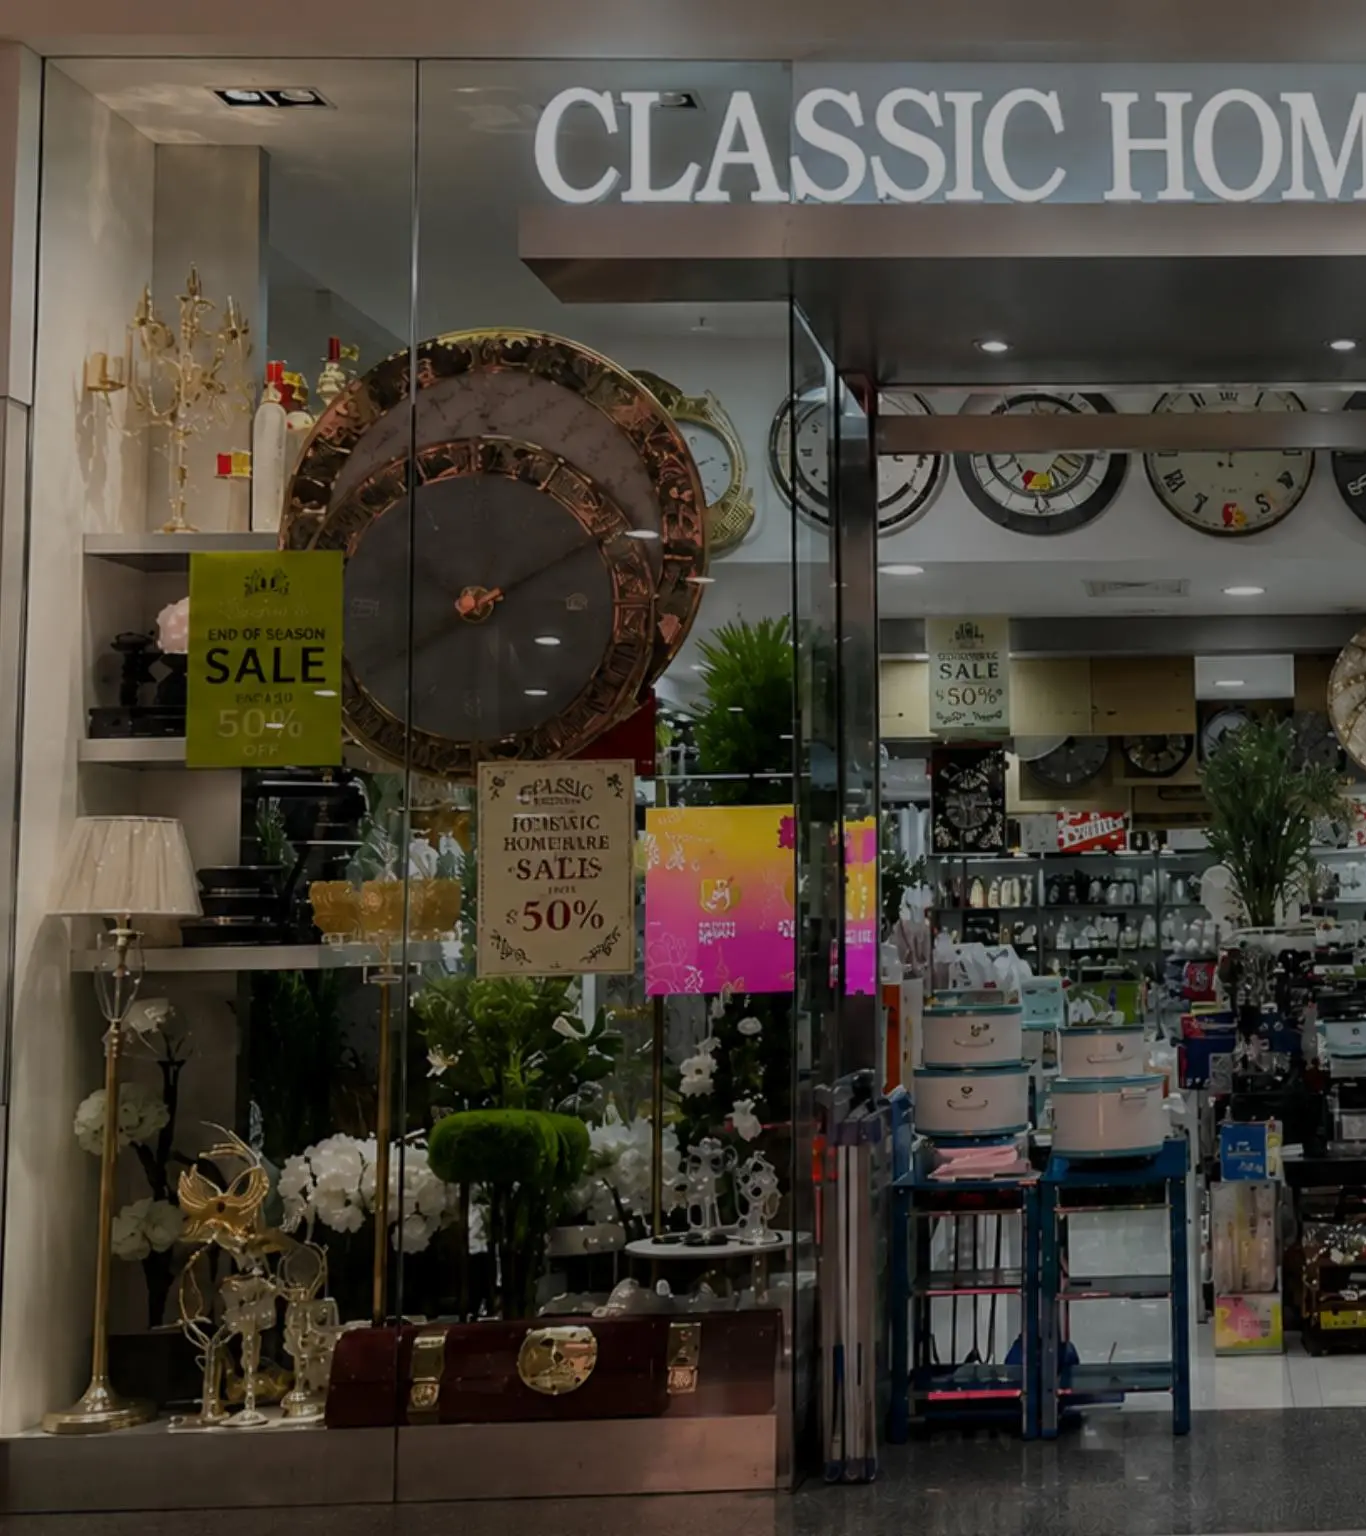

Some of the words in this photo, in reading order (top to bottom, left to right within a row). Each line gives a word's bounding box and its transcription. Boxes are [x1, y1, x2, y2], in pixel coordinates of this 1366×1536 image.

[534, 86, 1067, 203] CLASSIC
[208, 628, 238, 641] END
[243, 628, 261, 641] OF
[266, 627, 326, 641] SEASON
[205, 646, 327, 684] SALE
[940, 661, 999, 680] SALE
[216, 708, 304, 739] 50%
[522, 899, 605, 932] 50%
